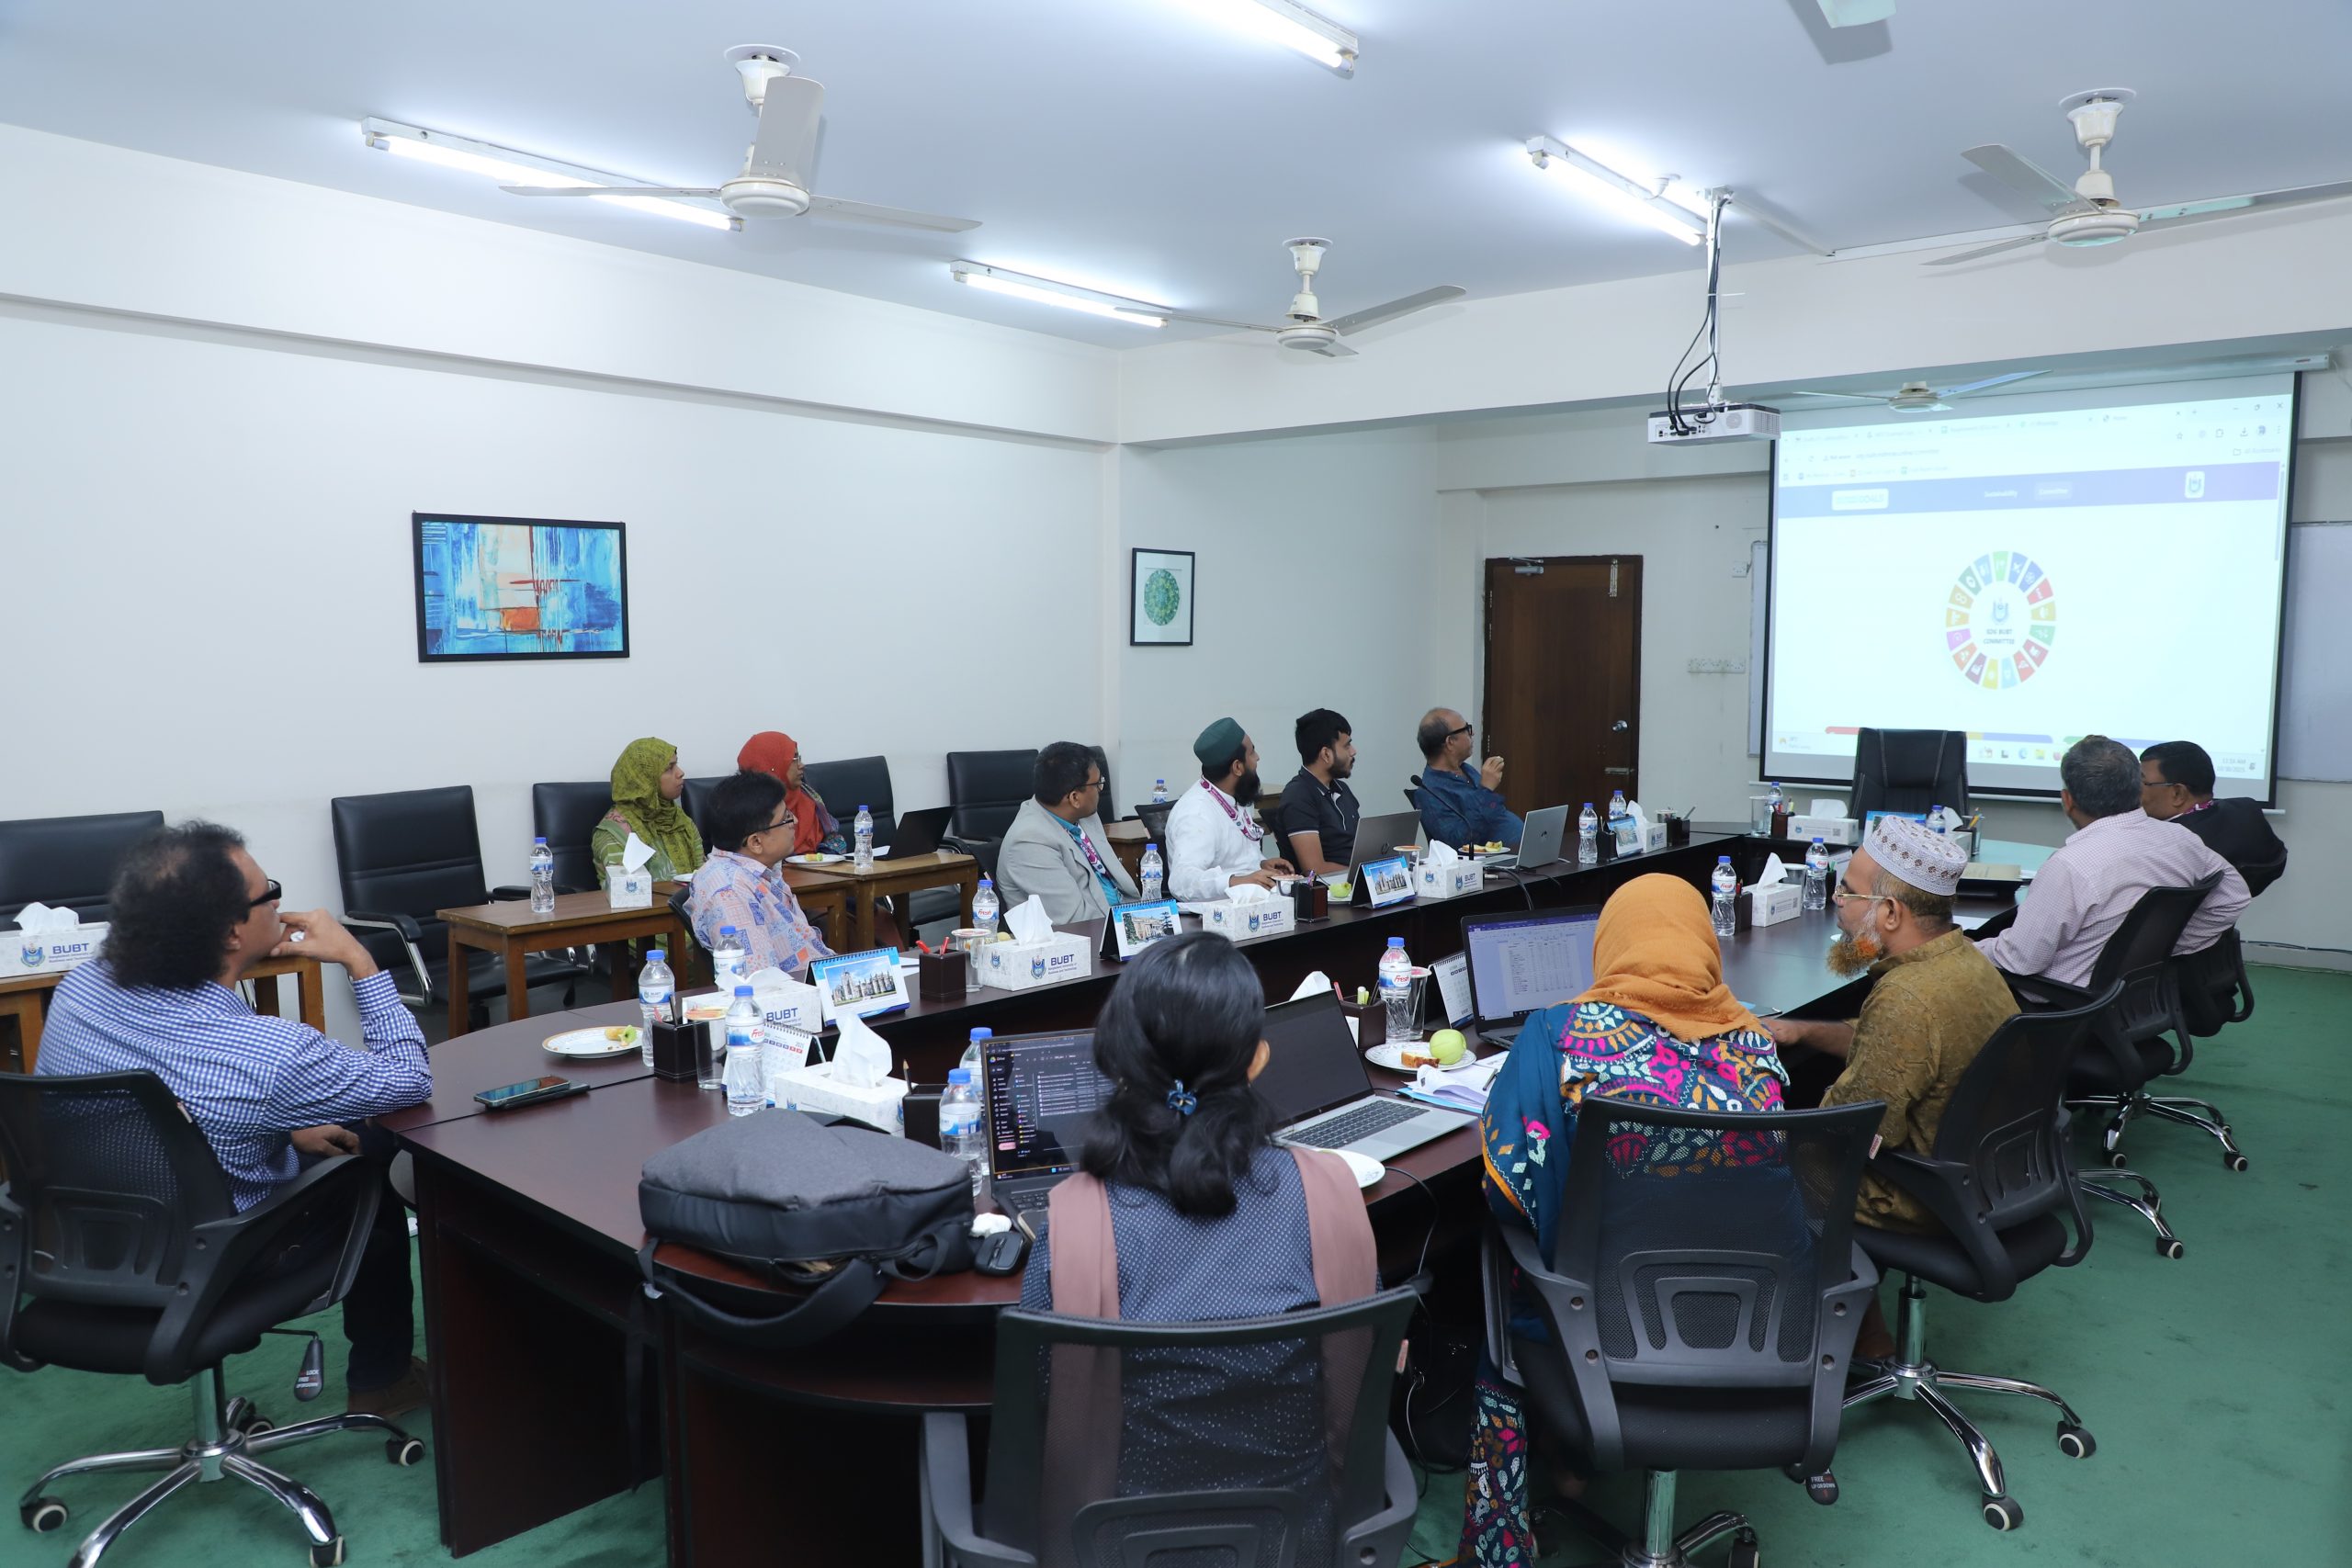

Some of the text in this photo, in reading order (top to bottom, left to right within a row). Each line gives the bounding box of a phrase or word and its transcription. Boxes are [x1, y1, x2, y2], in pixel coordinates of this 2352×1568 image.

[1262, 910, 1282, 921] BUBT
[52, 942, 89, 954] BUBT
[1050, 953, 1075, 966] BUBT
[766, 1007, 798, 1022] BUBT
